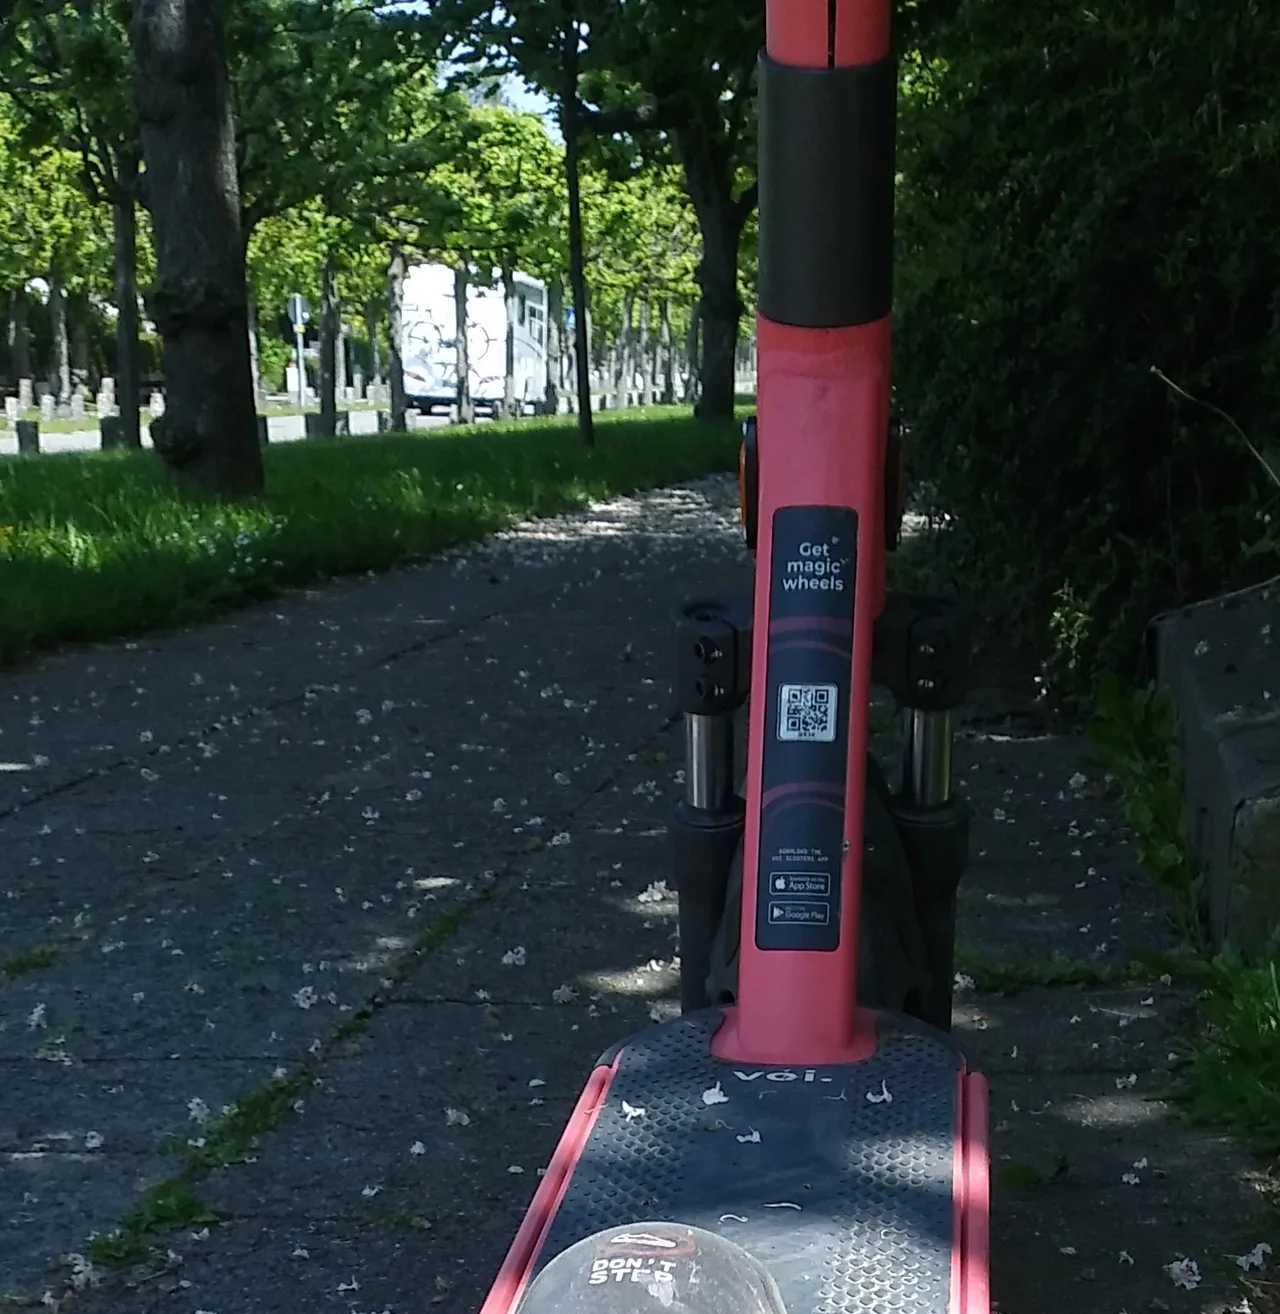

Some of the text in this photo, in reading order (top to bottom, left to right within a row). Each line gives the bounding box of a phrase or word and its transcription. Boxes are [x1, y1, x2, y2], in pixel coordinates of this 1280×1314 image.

[799, 542, 829, 556] Get
[787, 557, 840, 575] magic
[782, 575, 844, 591] wheels
[789, 881, 825, 891] App Store
[785, 910, 825, 920] Google Play
[592, 1258, 677, 1272] DON'T
